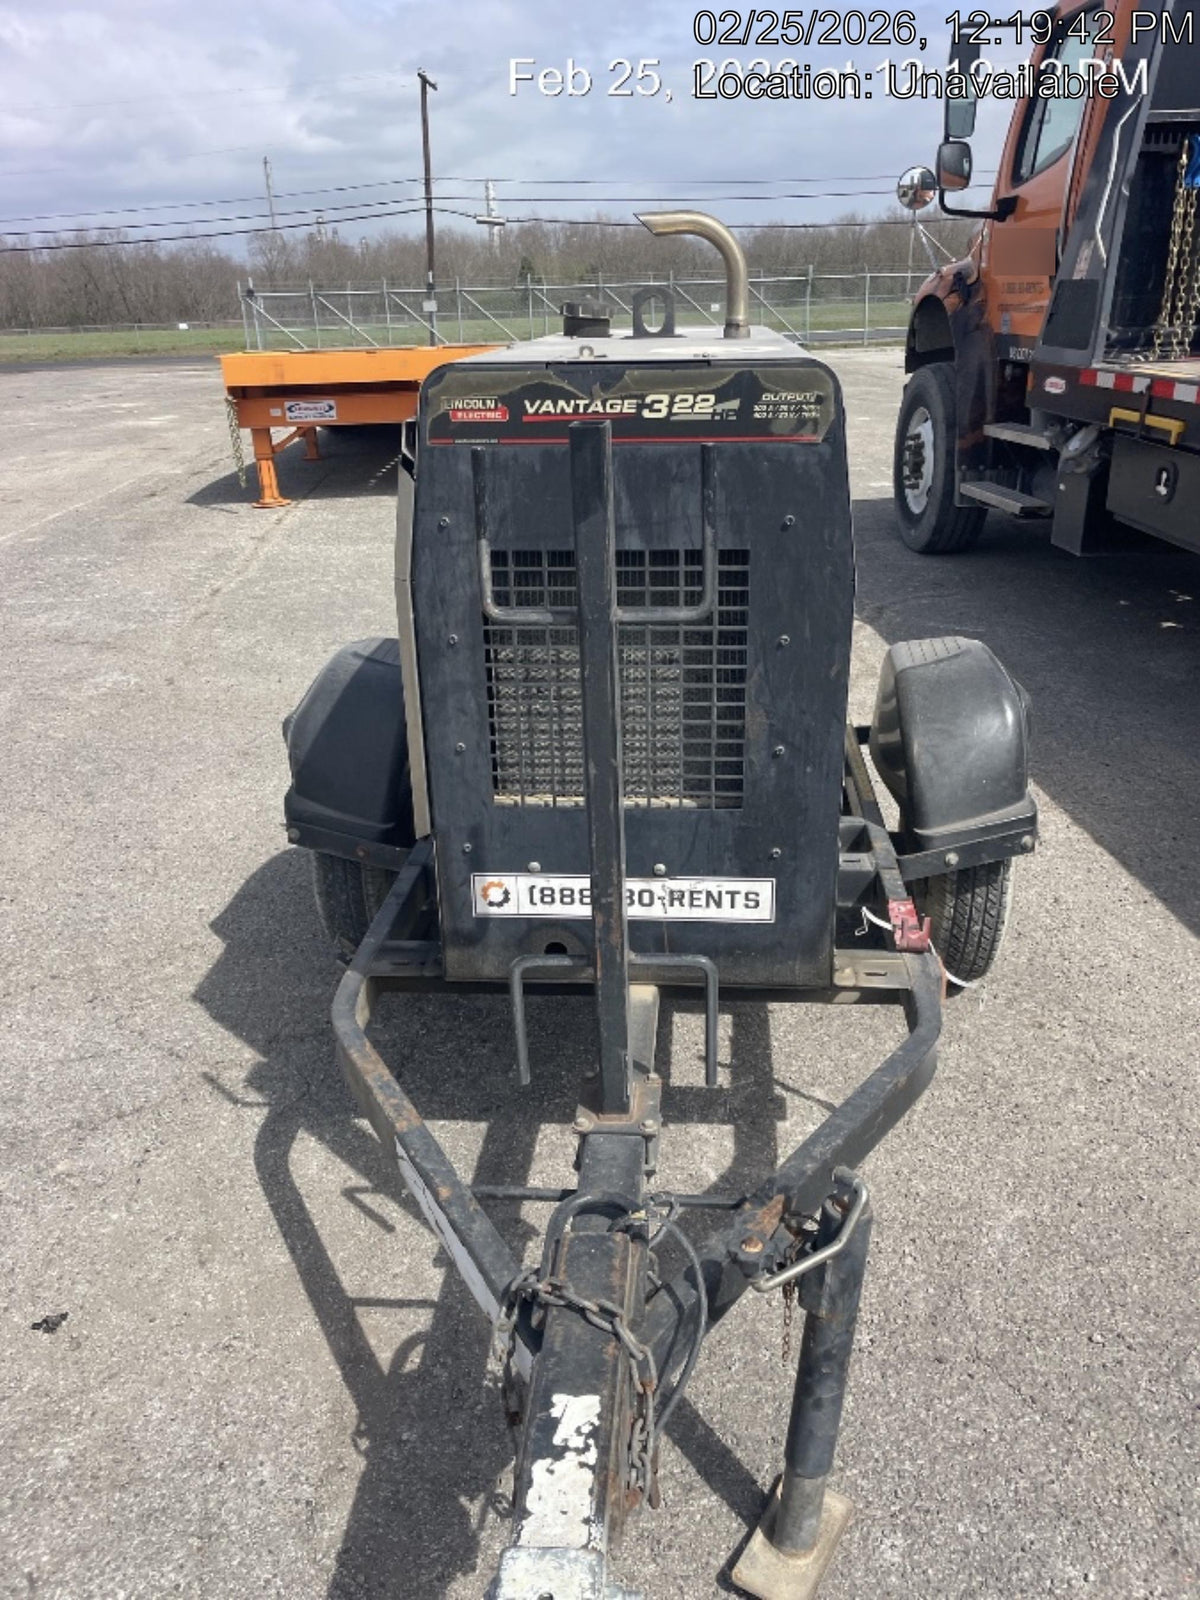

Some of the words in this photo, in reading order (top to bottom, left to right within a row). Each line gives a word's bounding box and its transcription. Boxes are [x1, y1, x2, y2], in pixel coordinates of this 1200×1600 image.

[443, 399, 496, 410] LINCOLN
[522, 399, 638, 414] VANTAGE
[641, 393, 716, 419] 322
